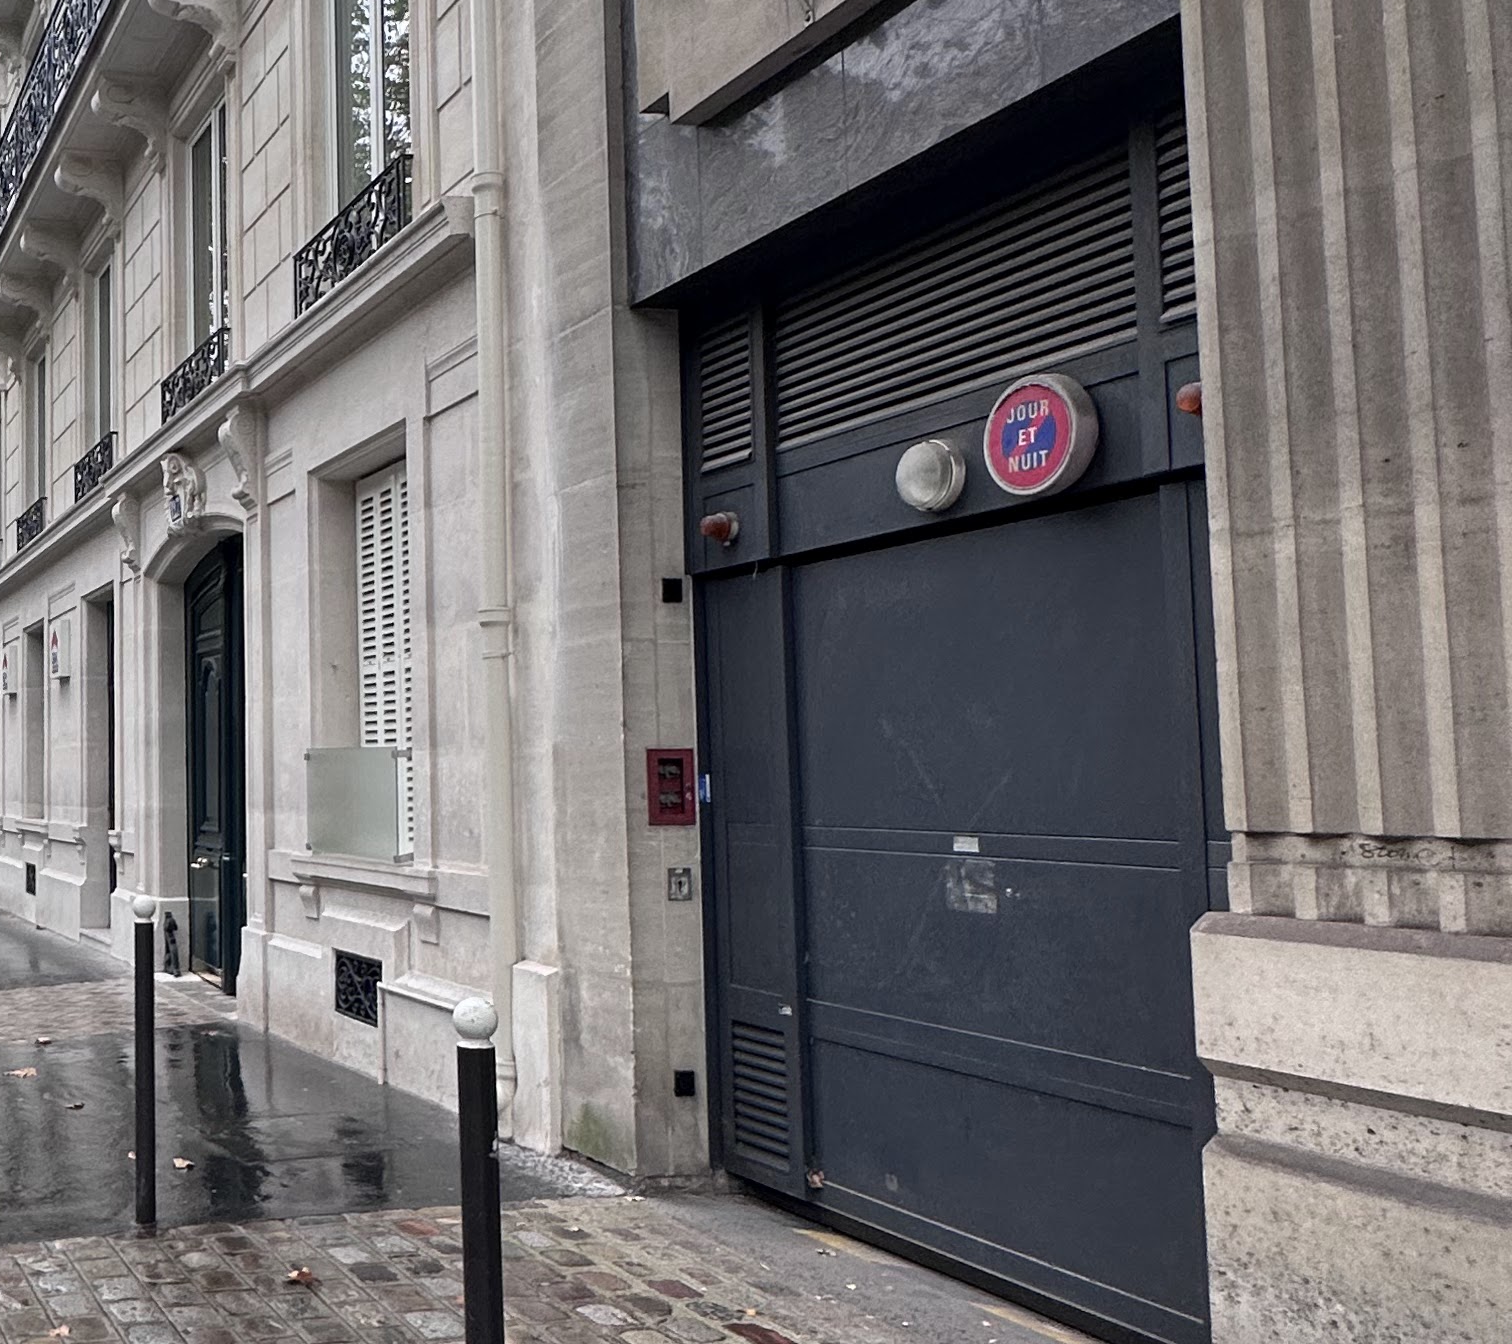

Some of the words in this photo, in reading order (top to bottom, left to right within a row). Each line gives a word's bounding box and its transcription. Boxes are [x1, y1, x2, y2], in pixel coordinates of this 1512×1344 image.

[1006, 399, 1050, 424] JOUR
[1018, 426, 1038, 446] ET
[1008, 449, 1049, 473] NUIT
